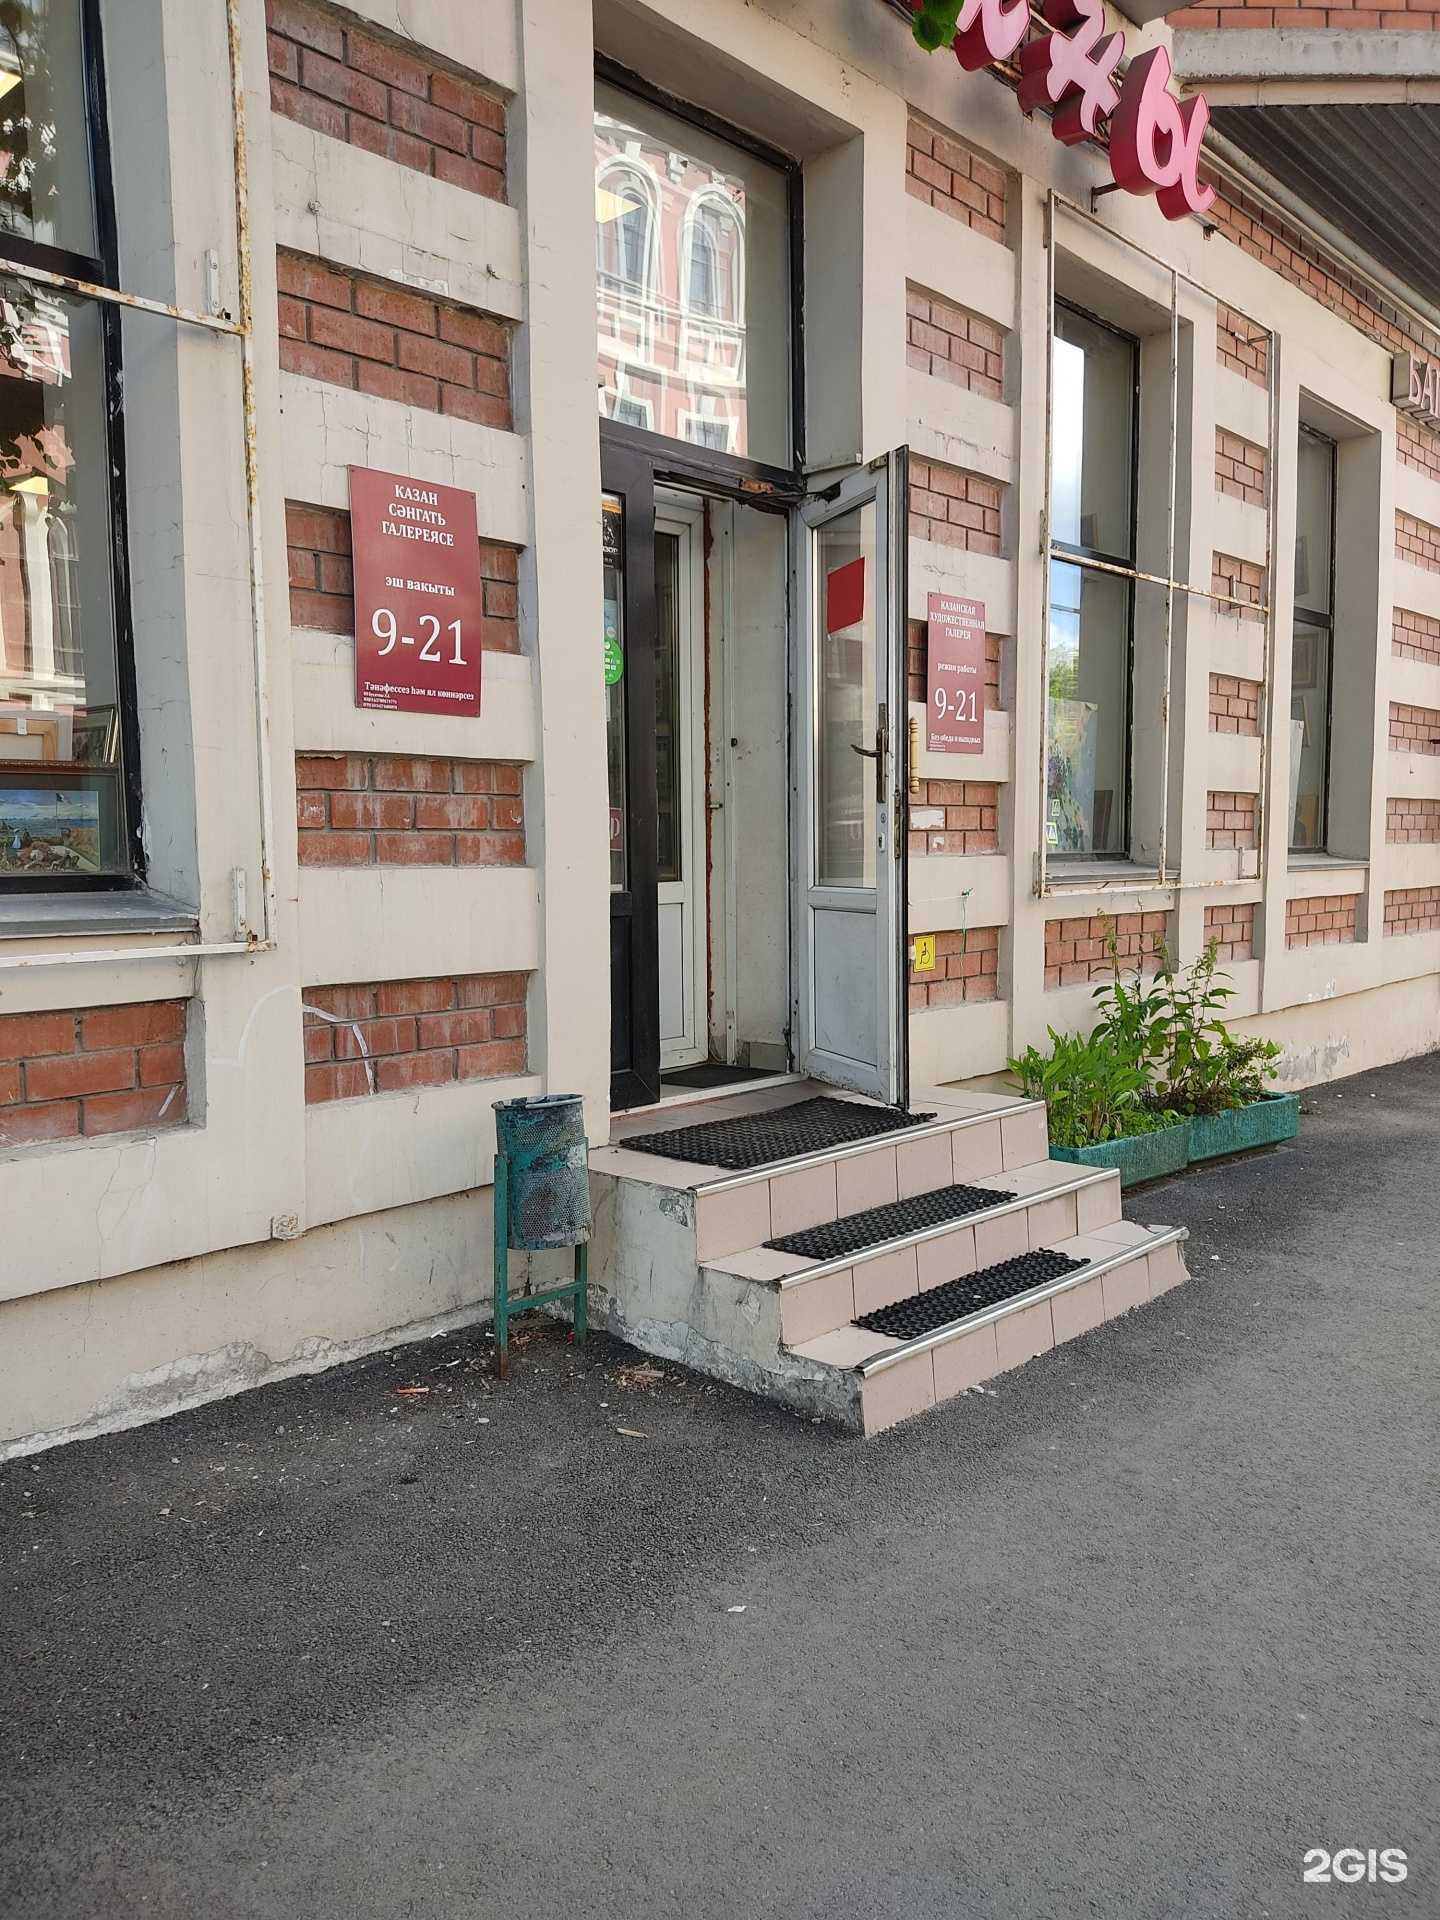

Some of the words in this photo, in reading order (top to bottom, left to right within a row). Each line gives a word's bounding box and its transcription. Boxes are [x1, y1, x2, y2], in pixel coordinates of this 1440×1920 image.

[394, 484, 439, 506] КАЗАН
[388, 503, 446, 526] СӘНГАТЬ
[381, 520, 455, 547] ГАЛЕРЕЯСЕ
[385, 576, 404, 589] эш
[407, 578, 455, 597] вакыты
[940, 599, 976, 616] КАЗАНСКАЯ
[371, 607, 468, 666] 9-21
[945, 627, 971, 641] ГАЛЕРЕЯ
[957, 664, 977, 675] работы
[934, 687, 978, 722] 9-21
